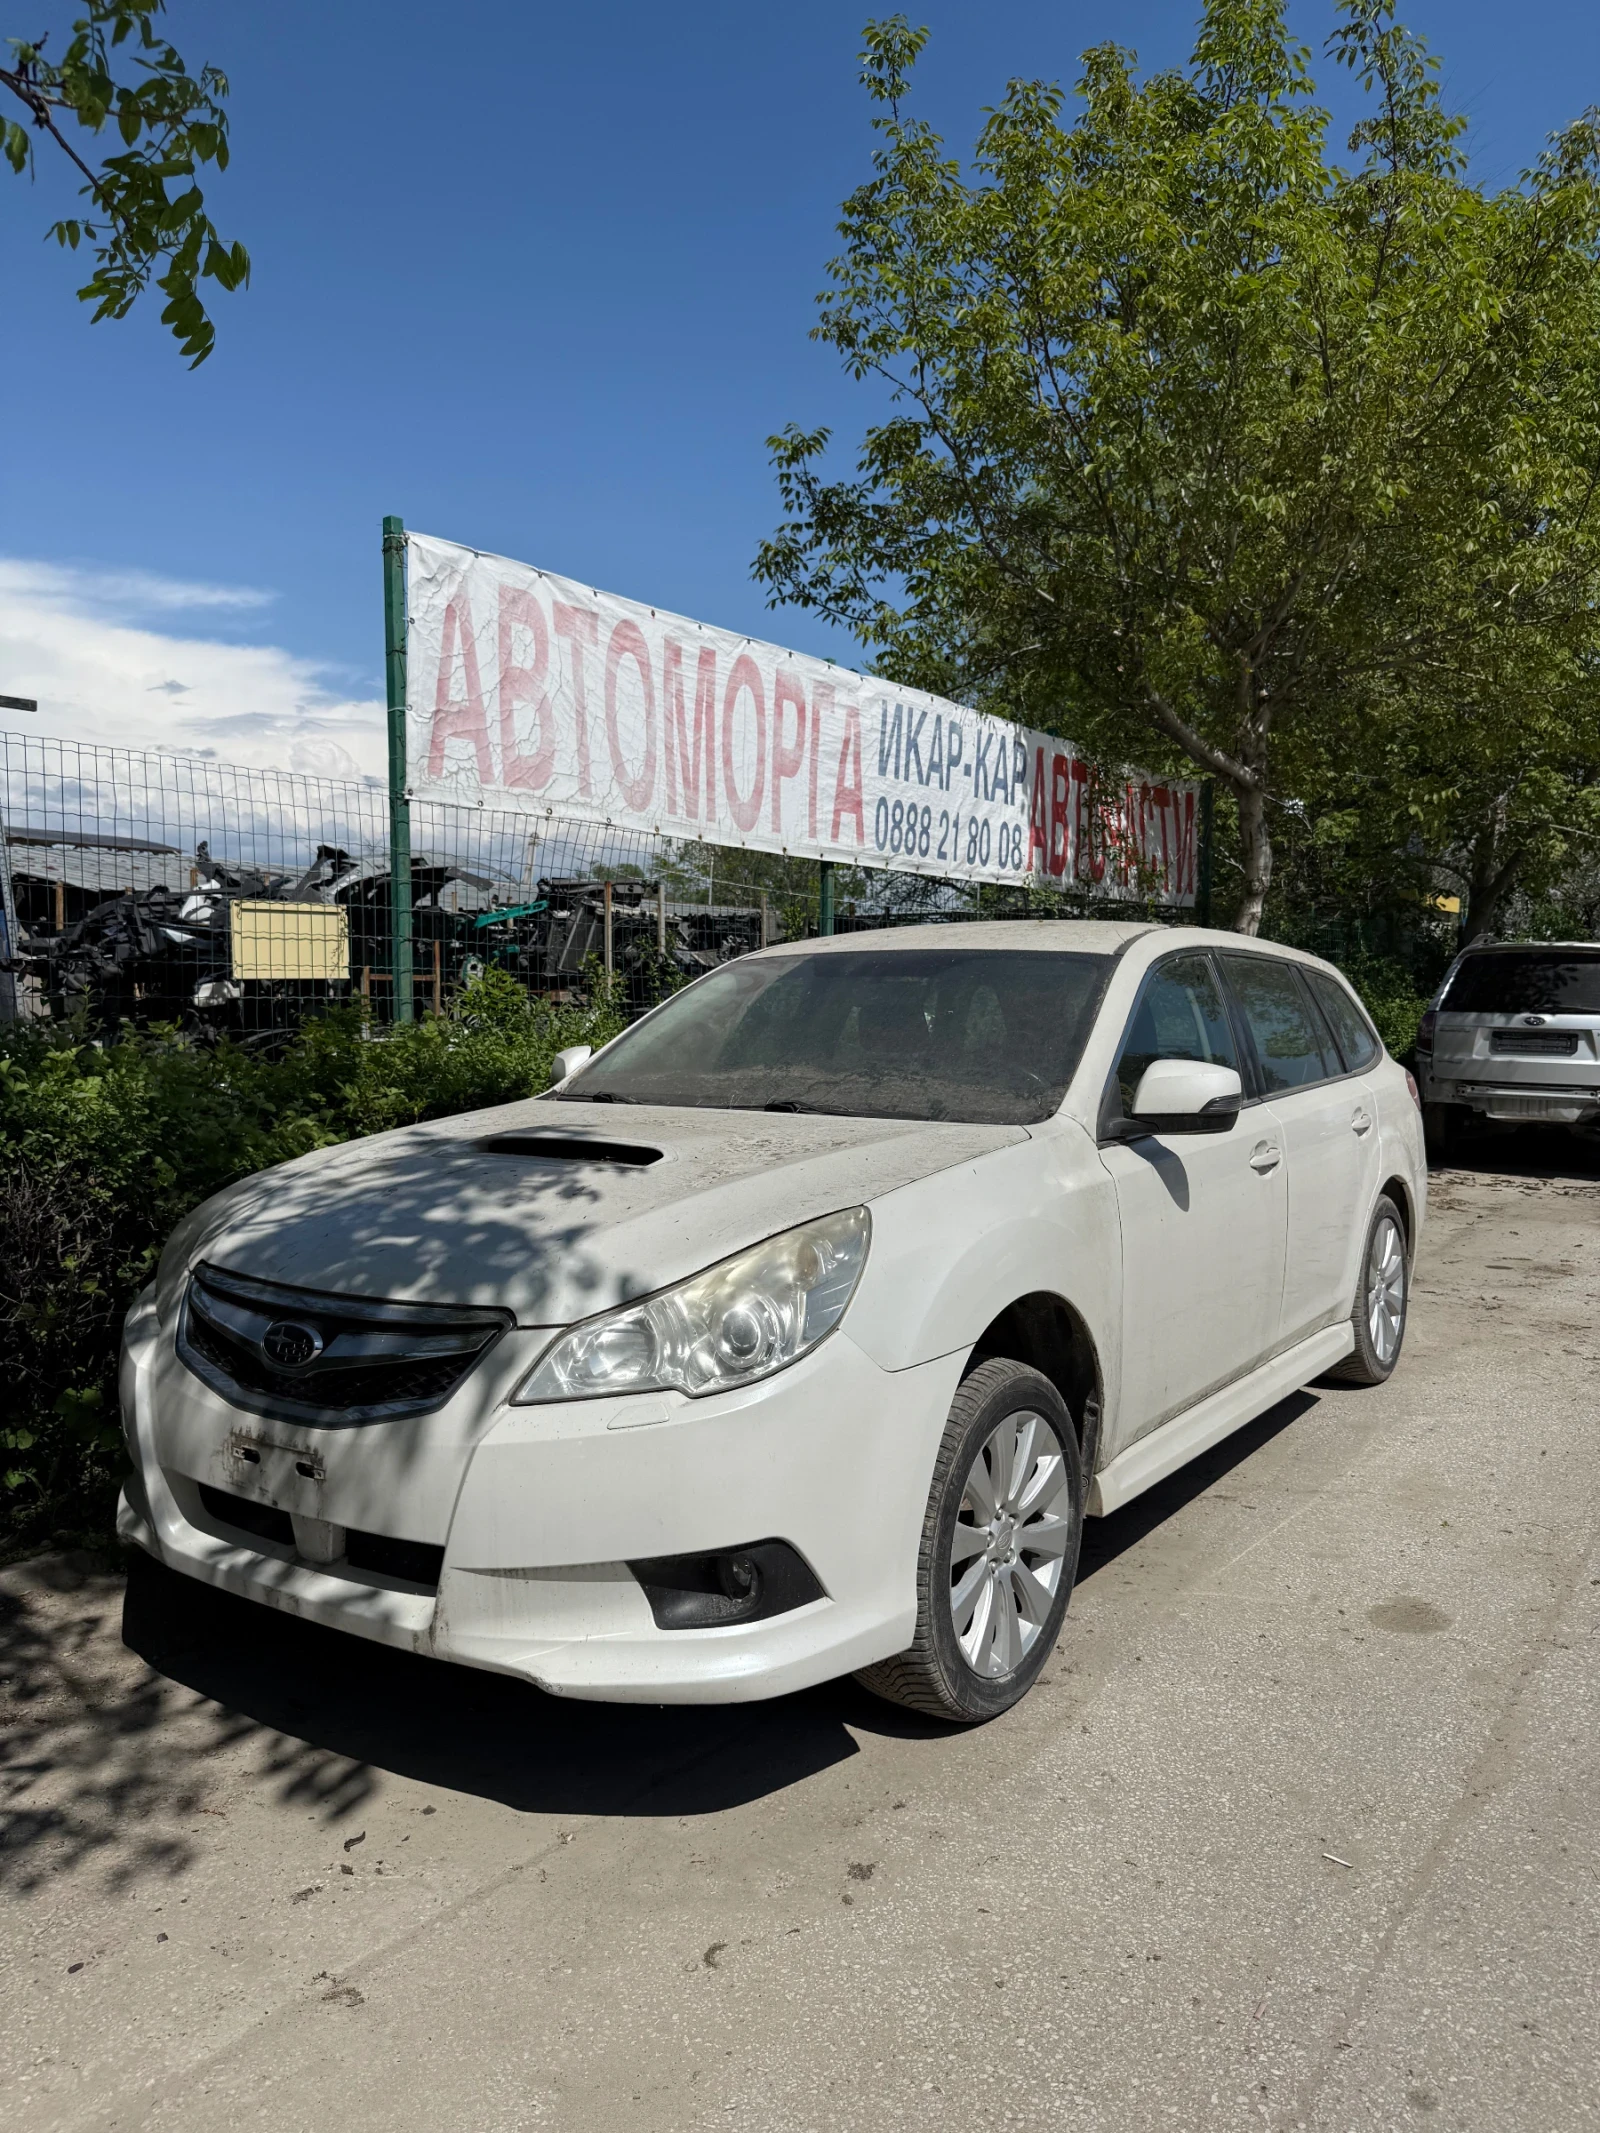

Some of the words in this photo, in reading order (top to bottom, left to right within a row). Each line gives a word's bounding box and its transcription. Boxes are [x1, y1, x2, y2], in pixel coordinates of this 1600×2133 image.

[428, 578, 865, 846] АВТОМОРГА
[878, 699, 1027, 806] ИКАР-КАР
[875, 796, 931, 857] 0888
[937, 809, 959, 862] 21
[967, 816, 991, 866] 80
[999, 821, 1022, 871] 08
